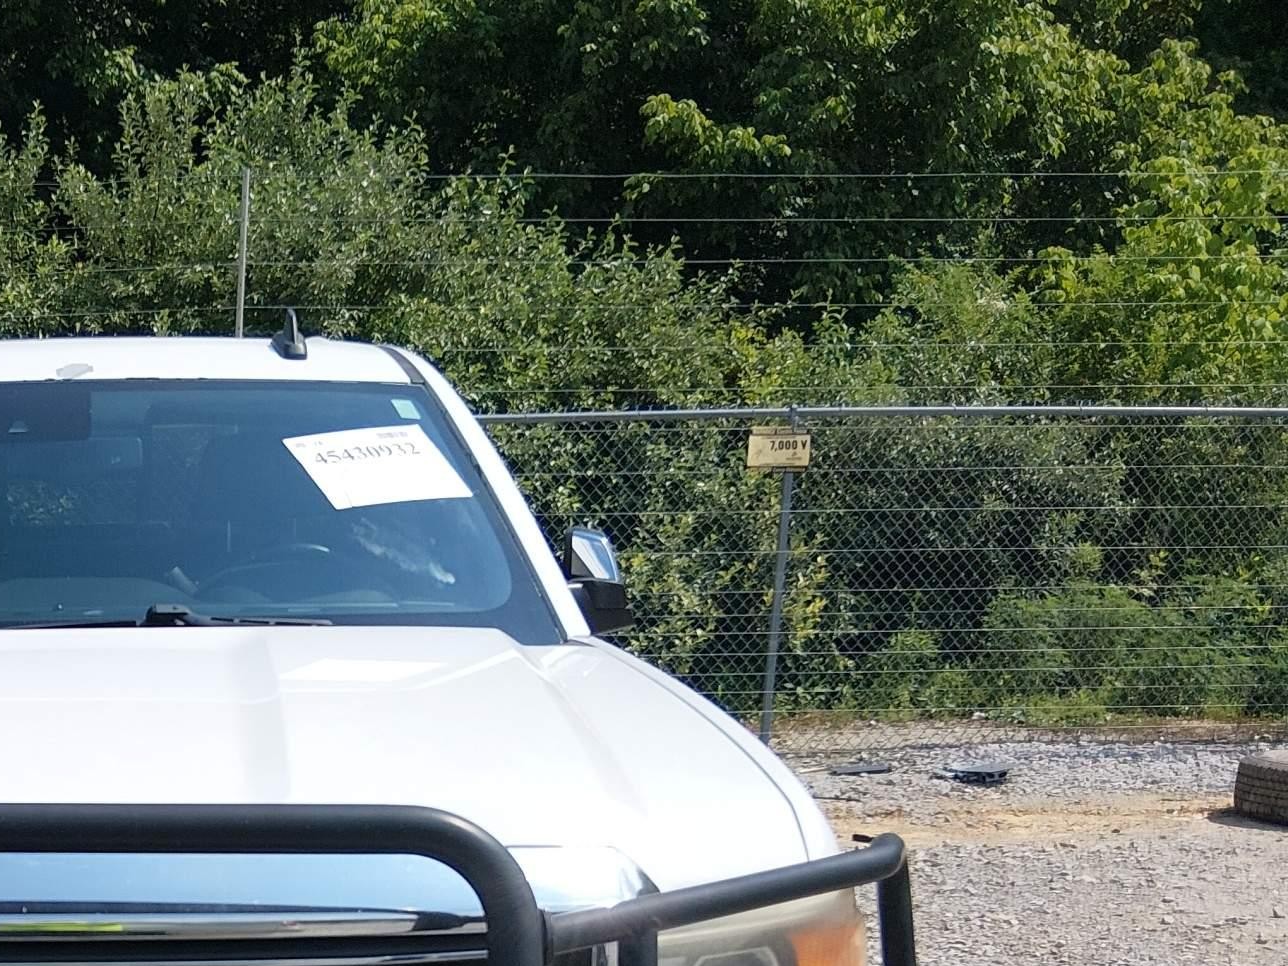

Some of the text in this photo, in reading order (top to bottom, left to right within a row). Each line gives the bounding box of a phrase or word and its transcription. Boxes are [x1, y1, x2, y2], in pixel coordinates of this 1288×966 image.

[315, 442, 421, 465] 45430932
[770, 439, 808, 452] 7,000 V
